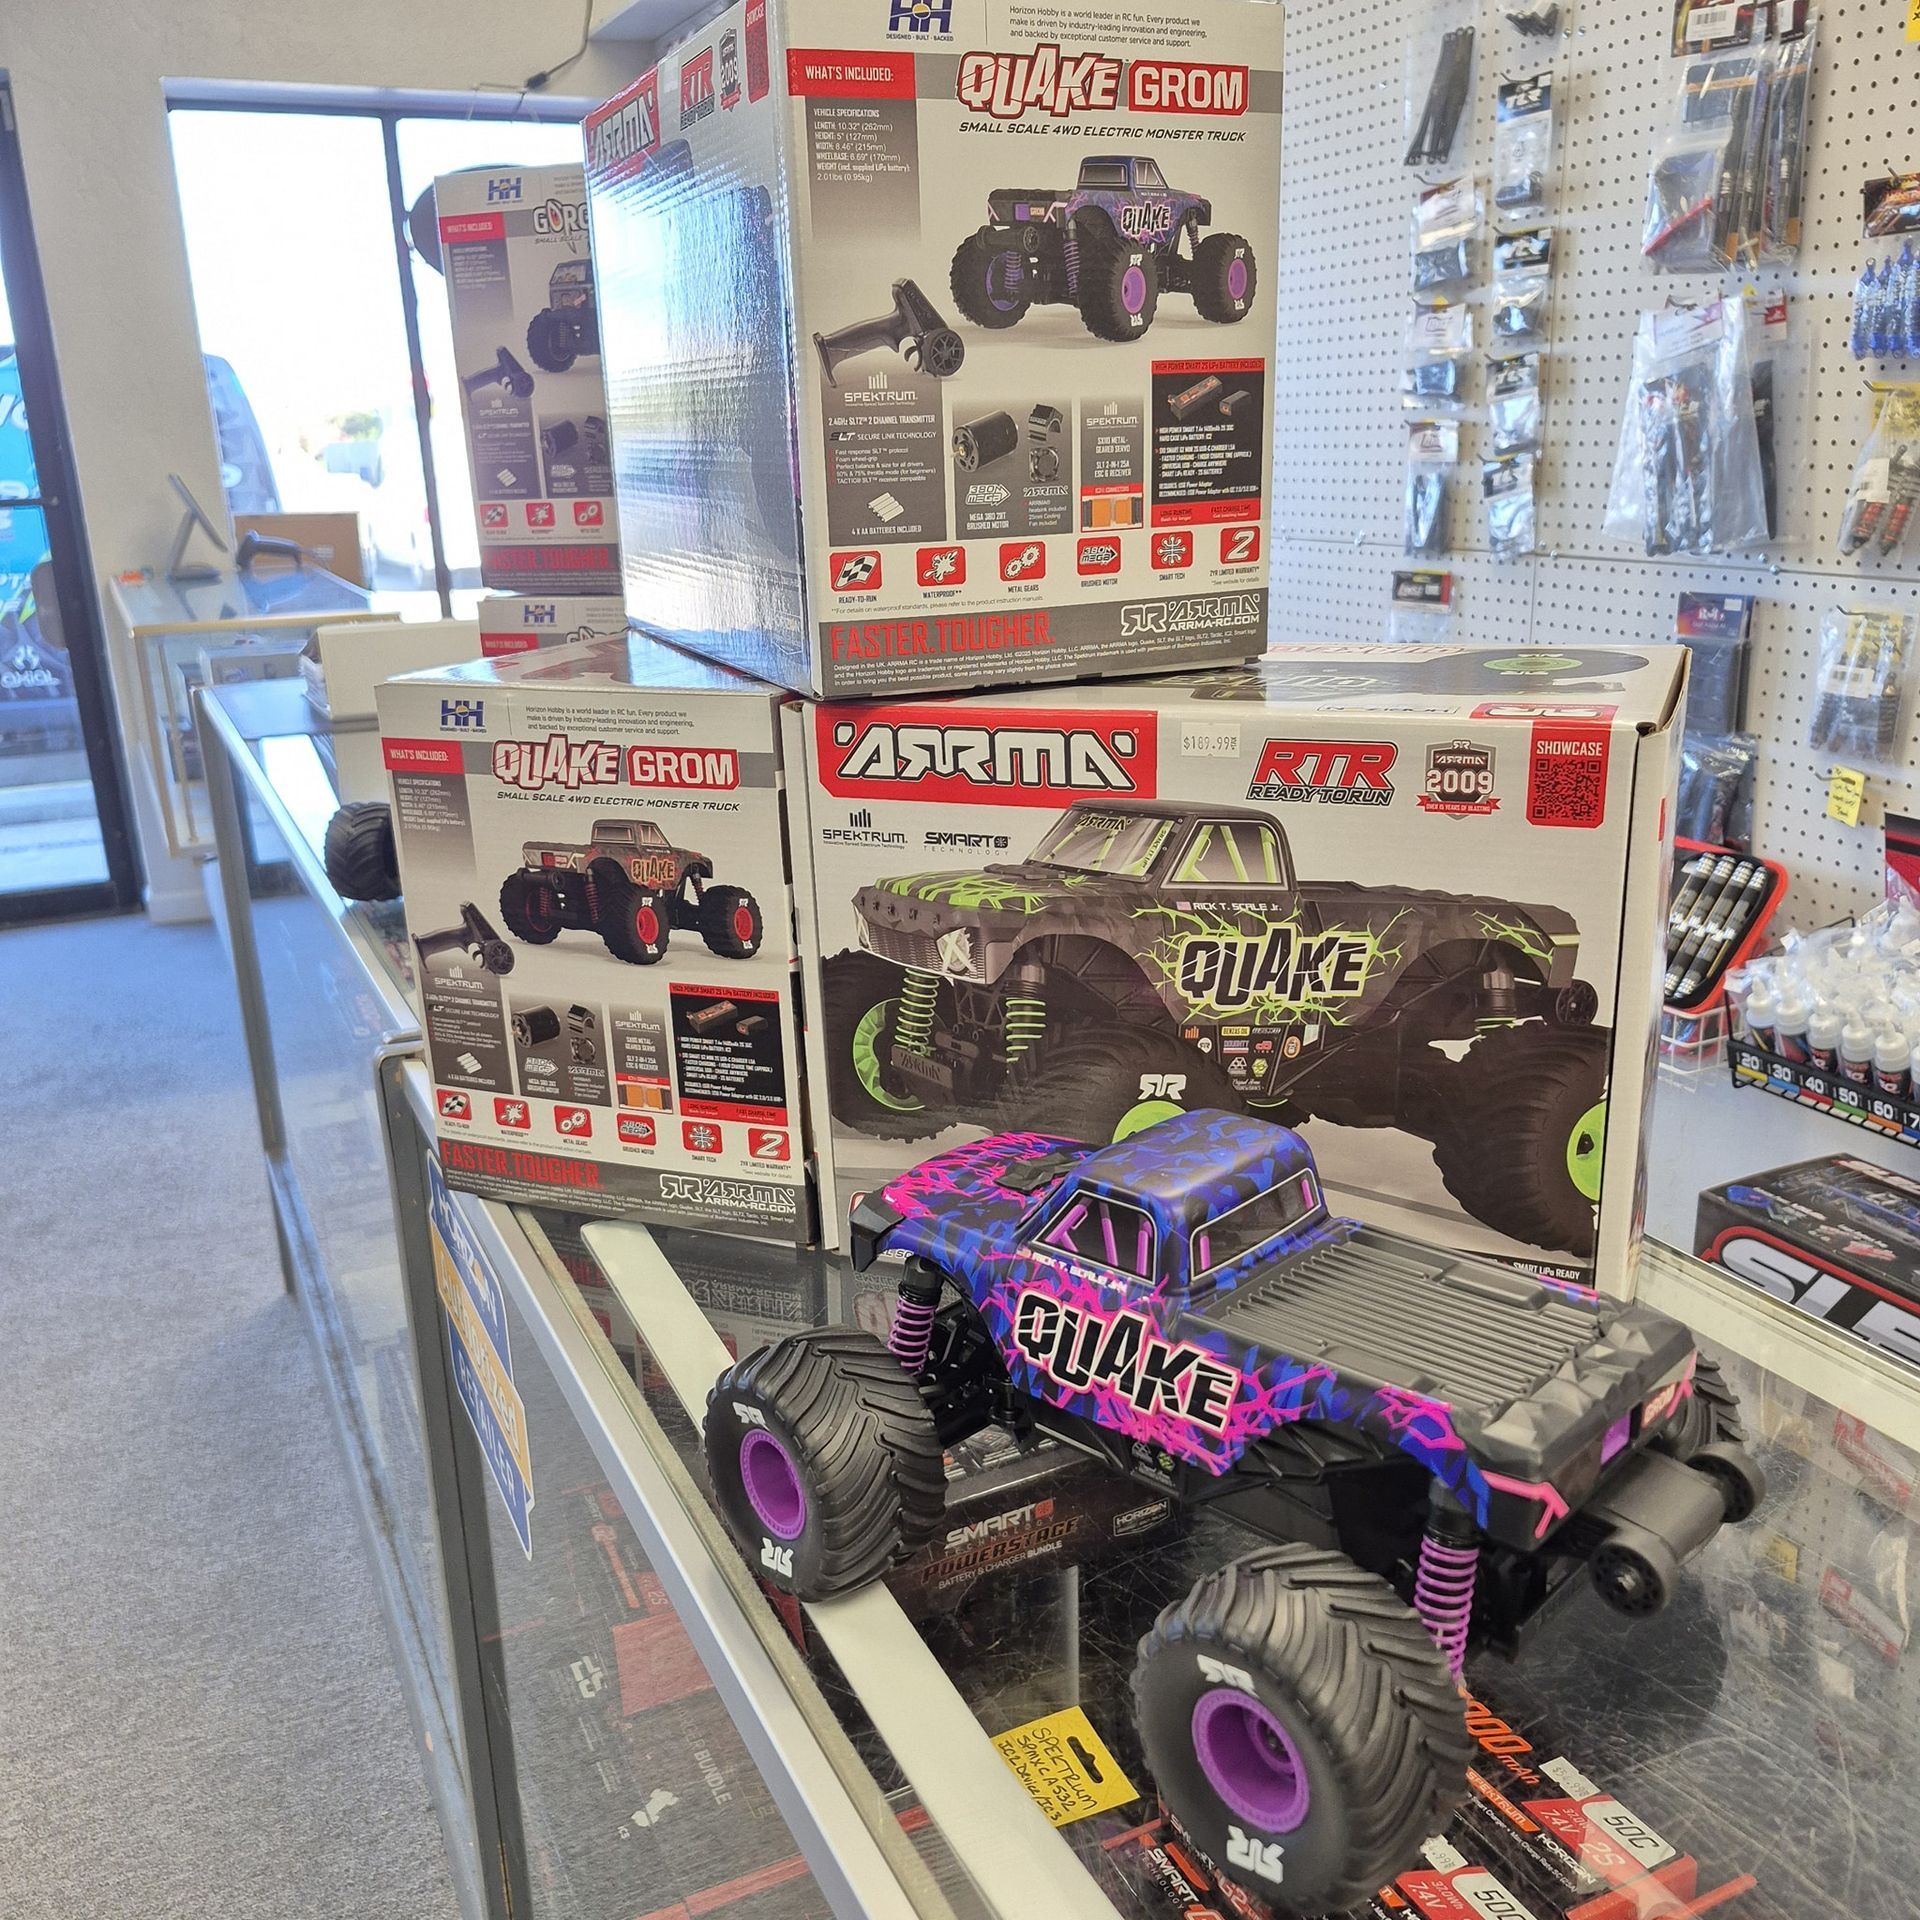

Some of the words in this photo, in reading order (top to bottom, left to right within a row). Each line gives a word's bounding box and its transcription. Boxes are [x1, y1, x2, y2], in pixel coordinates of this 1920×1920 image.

[1010, 5, 1036, 15] Horizon
[1037, 8, 1059, 17] Hobby
[1073, 10, 1092, 18] world
[1093, 11, 1113, 19] leader
[1122, 13, 1131, 21] RC
[1146, 14, 1164, 24] Every
[1166, 17, 1190, 25] product
[1010, 18, 1028, 26] make
[1036, 19, 1058, 27] driven
[1058, 20, 1066, 29] by
[1068, 21, 1121, 33] industry-leading
[1122, 25, 1155, 34] innovation
[1170, 29, 1208, 38] engineering,
[1024, 30, 1048, 38] backed
[1050, 32, 1058, 40] by
[1060, 32, 1096, 41] exceptional
[1098, 35, 1128, 44] customer
[1166, 40, 1191, 48] support.
[805, 65, 842, 80] WHAT'S
[845, 66, 895, 82] INCLUDED:
[957, 43, 1122, 119] QUAKE
[1134, 66, 1243, 110] GROM
[862, 122, 893, 132] (262mm)
[959, 121, 1003, 134] SMALL
[1007, 123, 1050, 135] SCALE
[1052, 125, 1081, 136] 4WD
[1083, 126, 1143, 138] ELECTRIC
[1146, 128, 1204, 140] MONSTER
[1207, 130, 1247, 142] TRUCK
[846, 132, 878, 142] (127mm)
[855, 143, 887, 152] (215mm)
[870, 153, 901, 162] (170mm)
[1121, 204, 1171, 235] QUAKE
[844, 391, 916, 403] SPEKTRUM
[874, 416, 898, 425] CHANNEL
[899, 414, 936, 424] TRANSMITTER
[1086, 416, 1137, 426] SPEKTRUM
[857, 433, 881, 441] SECURE
[896, 432, 937, 440] TECHNOLOGY
[1023, 485, 1069, 498] ARRMA
[870, 526, 896, 535] BATTERIES
[896, 524, 922, 534] INCLUDED
[1225, 529, 1255, 561] 2
[1024, 584, 1040, 592] GEARS
[1102, 578, 1118, 586] MOTOR
[838, 595, 878, 604] READY-TO-RUN
[1169, 593, 1260, 622] ARRMA
[1168, 614, 1260, 632] ARRMA-RC.COM
[1183, 736, 1230, 751] $189.99
[1536, 740, 1603, 757] SHOWCASE
[390, 748, 416, 760] WHAT'S
[416, 750, 449, 761] INCLUDED:
[492, 734, 621, 791] QUAKE
[632, 753, 737, 786] GROM
[833, 721, 1140, 792] ARRMA
[1251, 737, 1398, 790] RTR
[1436, 755, 1486, 765] ARRMA
[1426, 769, 1494, 795] 2009
[496, 791, 530, 801] SMALL
[532, 793, 566, 803] SCALE
[567, 794, 591, 804] 4WD
[593, 796, 644, 807] ELECTRIC
[646, 799, 700, 810] MONSTER
[702, 801, 740, 812] TRUCK
[1075, 813, 1132, 832] ARRMA
[822, 829, 905, 844] SPEKTRUM
[923, 832, 994, 847] SMART
[923, 845, 1009, 856] TECHNOLOGY
[630, 855, 676, 882] QUAKE
[1193, 902, 1218, 910] RICK
[1232, 902, 1268, 911] SCALE
[1270, 903, 1283, 912] Jr.
[1177, 923, 1369, 1008] QUAKE
[434, 977, 485, 990] SPEKTRUM
[615, 1020, 661, 1031] SPEKTRUM
[1741, 1052, 1759, 1071] 20
[1772, 1064, 1792, 1082] 30
[1804, 1076, 1825, 1095] 40
[1838, 1089, 1858, 1107] 50
[1874, 1100, 1894, 1120] 60
[756, 1132, 784, 1157] 2
[749, 1161, 765, 1170] LIMITED
[703, 1178, 796, 1207] ARRMA
[705, 1197, 796, 1214] ARRMA-RC.COM
[1513, 1262, 1538, 1273] SMART
[1556, 1268, 1580, 1280] READY
[1013, 1289, 1242, 1437] QUAKE
[1116, 1500, 1168, 1526] HORIZON
[944, 1503, 1035, 1550] SMART
[938, 1570, 977, 1590] BATTERY
[984, 1553, 1027, 1574] CHARGER
[1027, 1540, 1063, 1558] BUNDLE
[693, 1742, 732, 1805] BUNDLE
[1032, 1727, 1098, 1811] SPEKTRUM
[1497, 1754, 1540, 1785] mAh
[1467, 1772, 1526, 1826] SPEKTRUM
[1540, 1809, 1580, 1834] 7.4V
[1603, 1814, 1661, 1850] 50C
[1536, 1832, 1597, 1885] HORIZON
[1139, 1851, 1185, 1910] TECHNOLOGY
[1147, 1847, 1200, 1903] SMART
[1407, 1880, 1448, 1910] 7.4V
